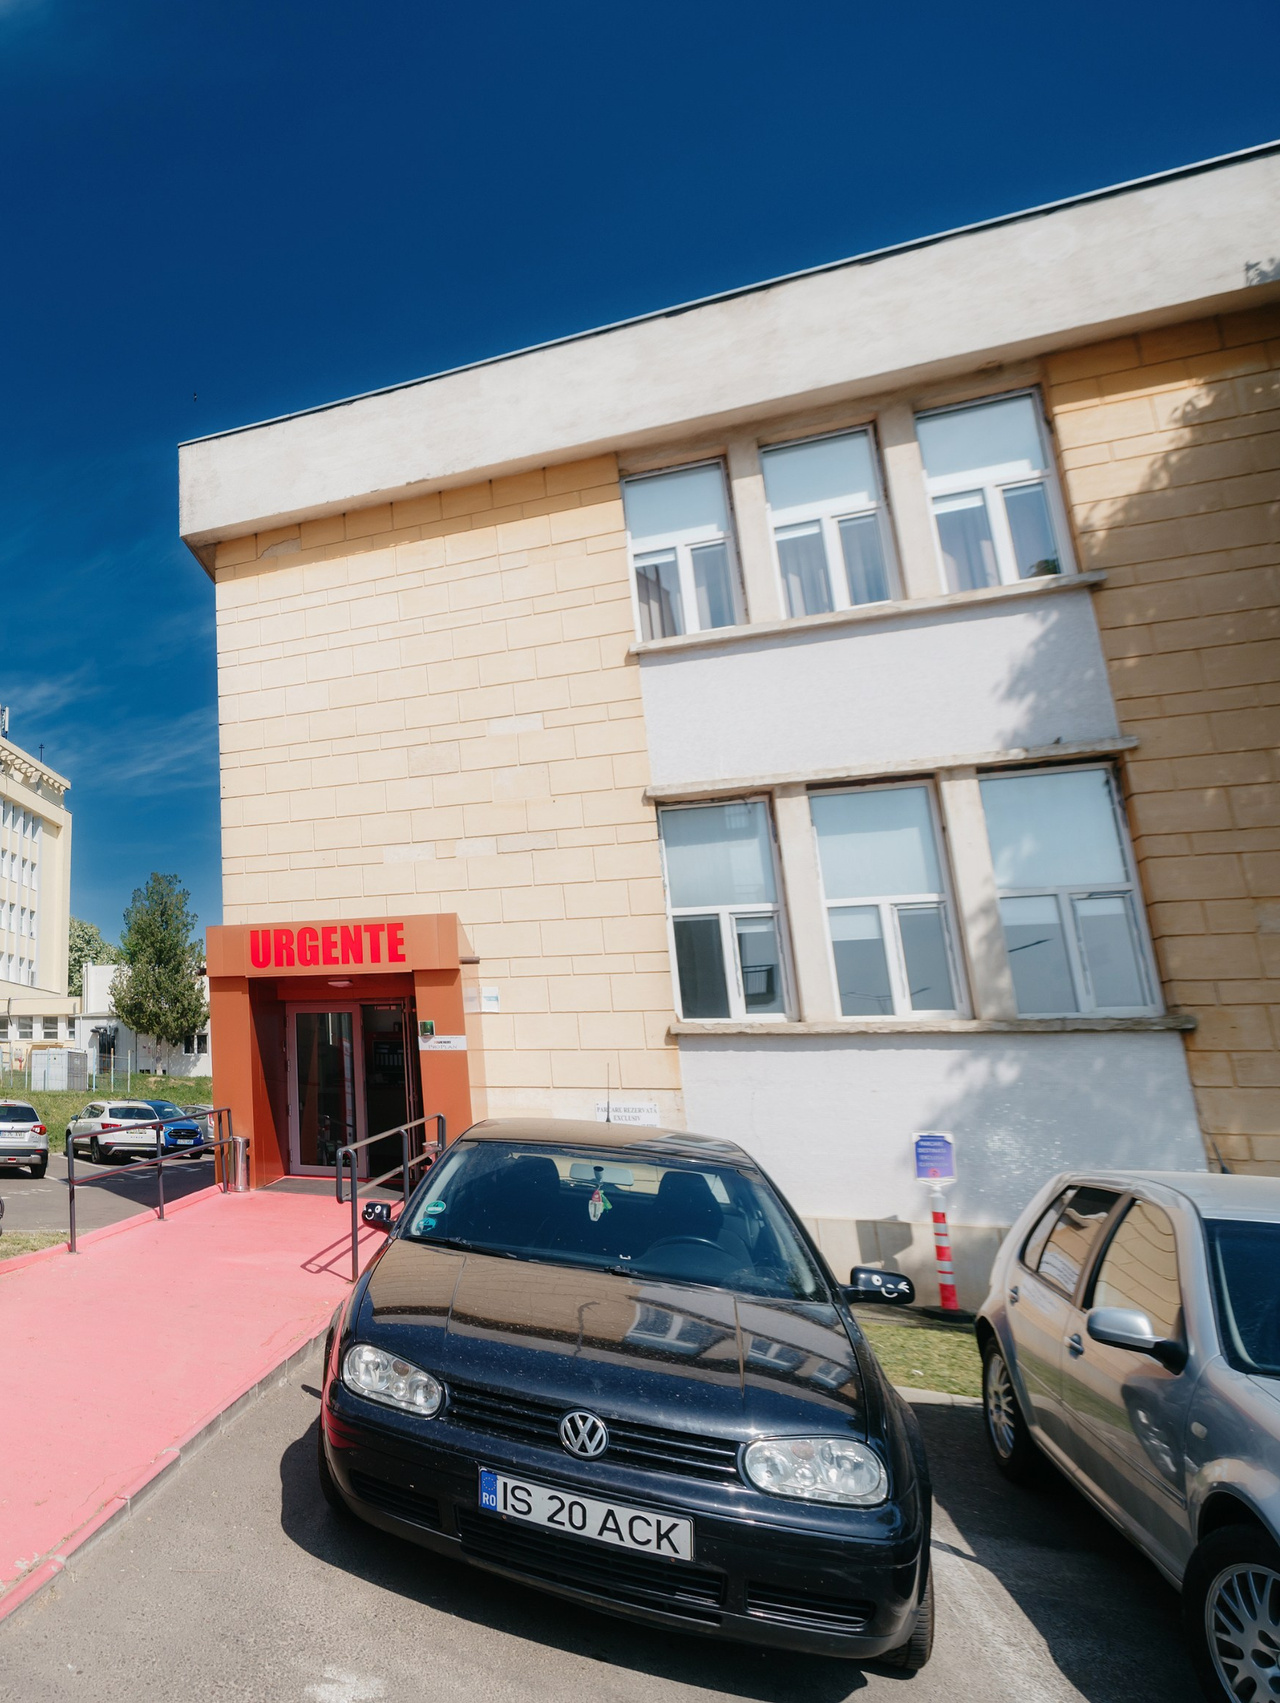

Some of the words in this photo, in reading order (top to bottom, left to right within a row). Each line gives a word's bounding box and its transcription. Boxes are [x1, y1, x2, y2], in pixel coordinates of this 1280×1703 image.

[249, 922, 406, 969] URGENTE
[482, 1492, 496, 1507] RO
[503, 1481, 532, 1515] IS
[547, 1495, 587, 1531] 20
[597, 1508, 680, 1554] ACK
